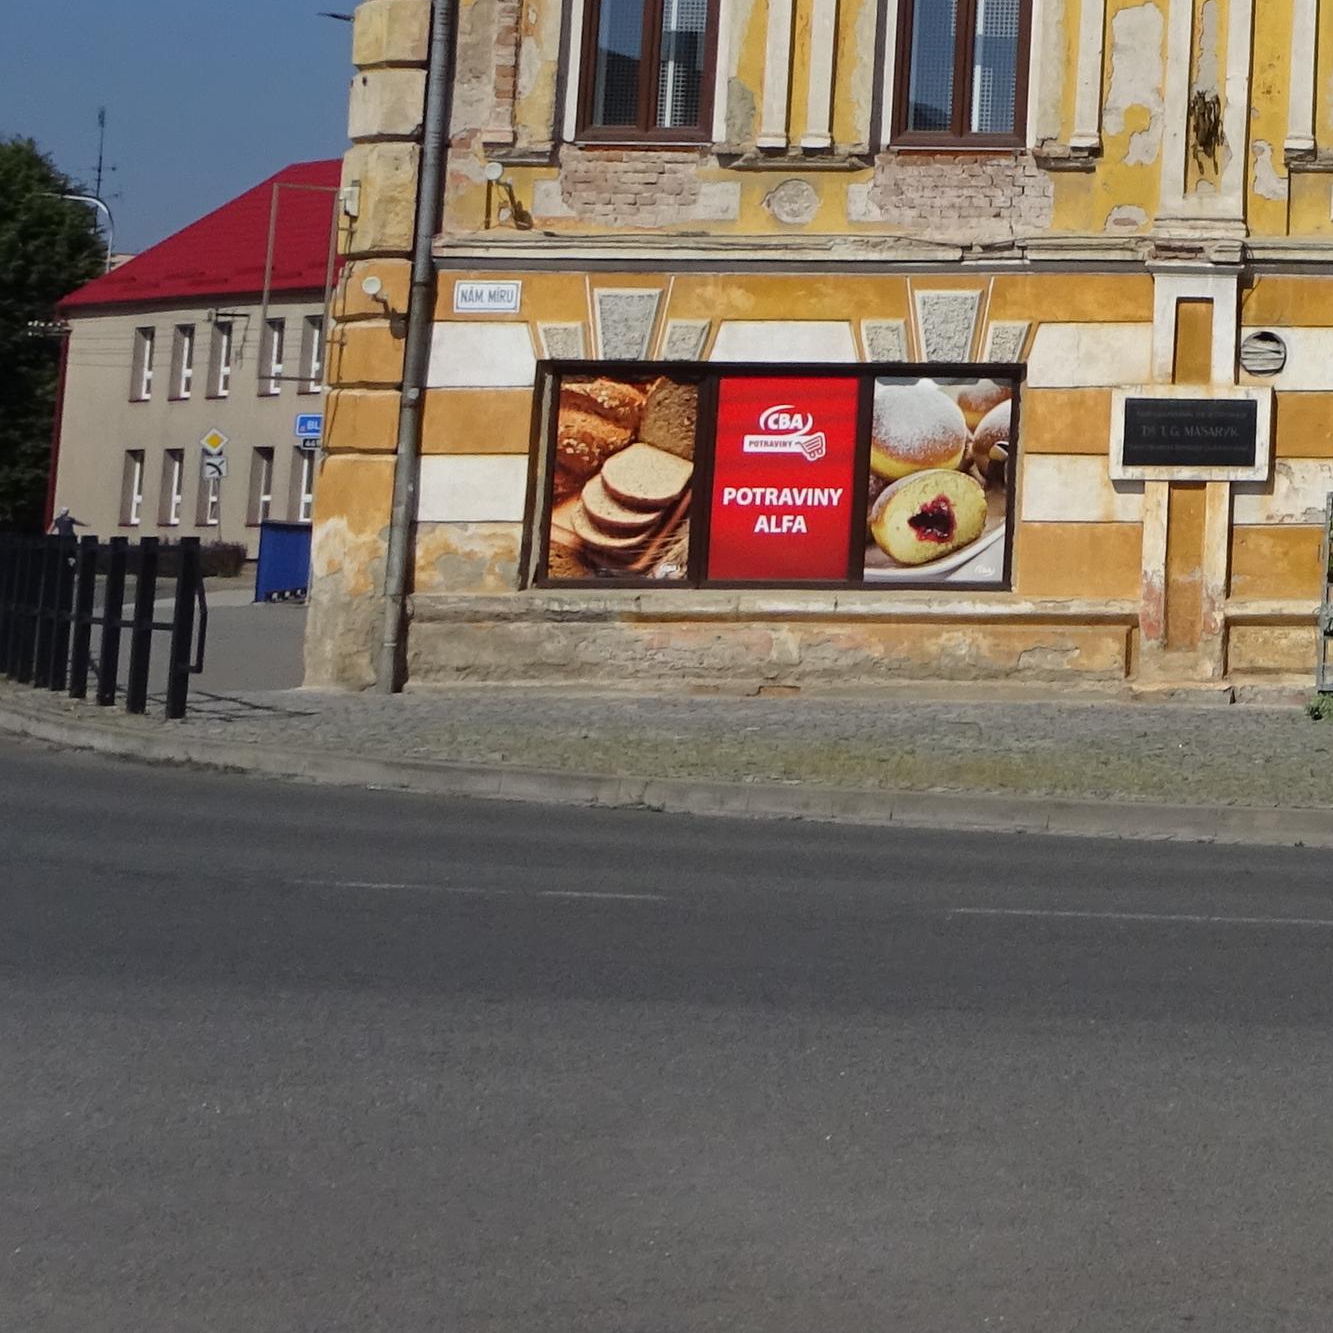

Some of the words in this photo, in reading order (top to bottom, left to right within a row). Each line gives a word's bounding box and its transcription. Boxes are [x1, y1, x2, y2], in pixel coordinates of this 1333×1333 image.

[766, 413, 804, 430] CBA
[723, 487, 843, 506] POTRAVINY
[754, 515, 807, 533] ALFA
